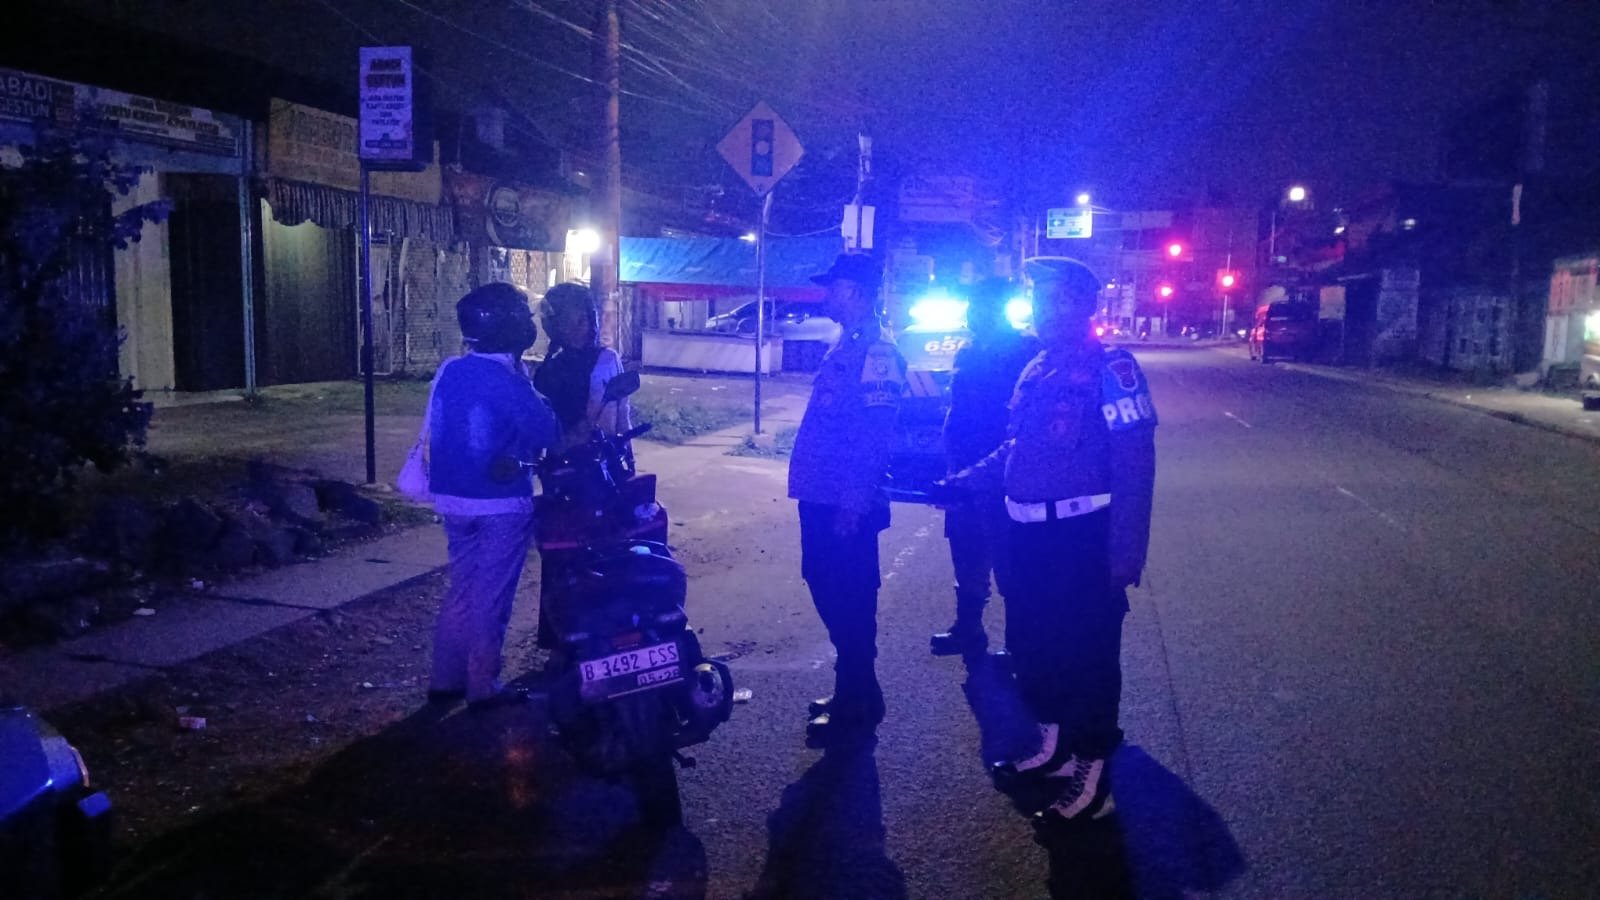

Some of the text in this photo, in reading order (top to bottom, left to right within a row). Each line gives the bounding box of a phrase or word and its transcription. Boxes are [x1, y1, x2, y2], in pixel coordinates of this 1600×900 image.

[585, 644, 677, 681] B 3492 CSS
